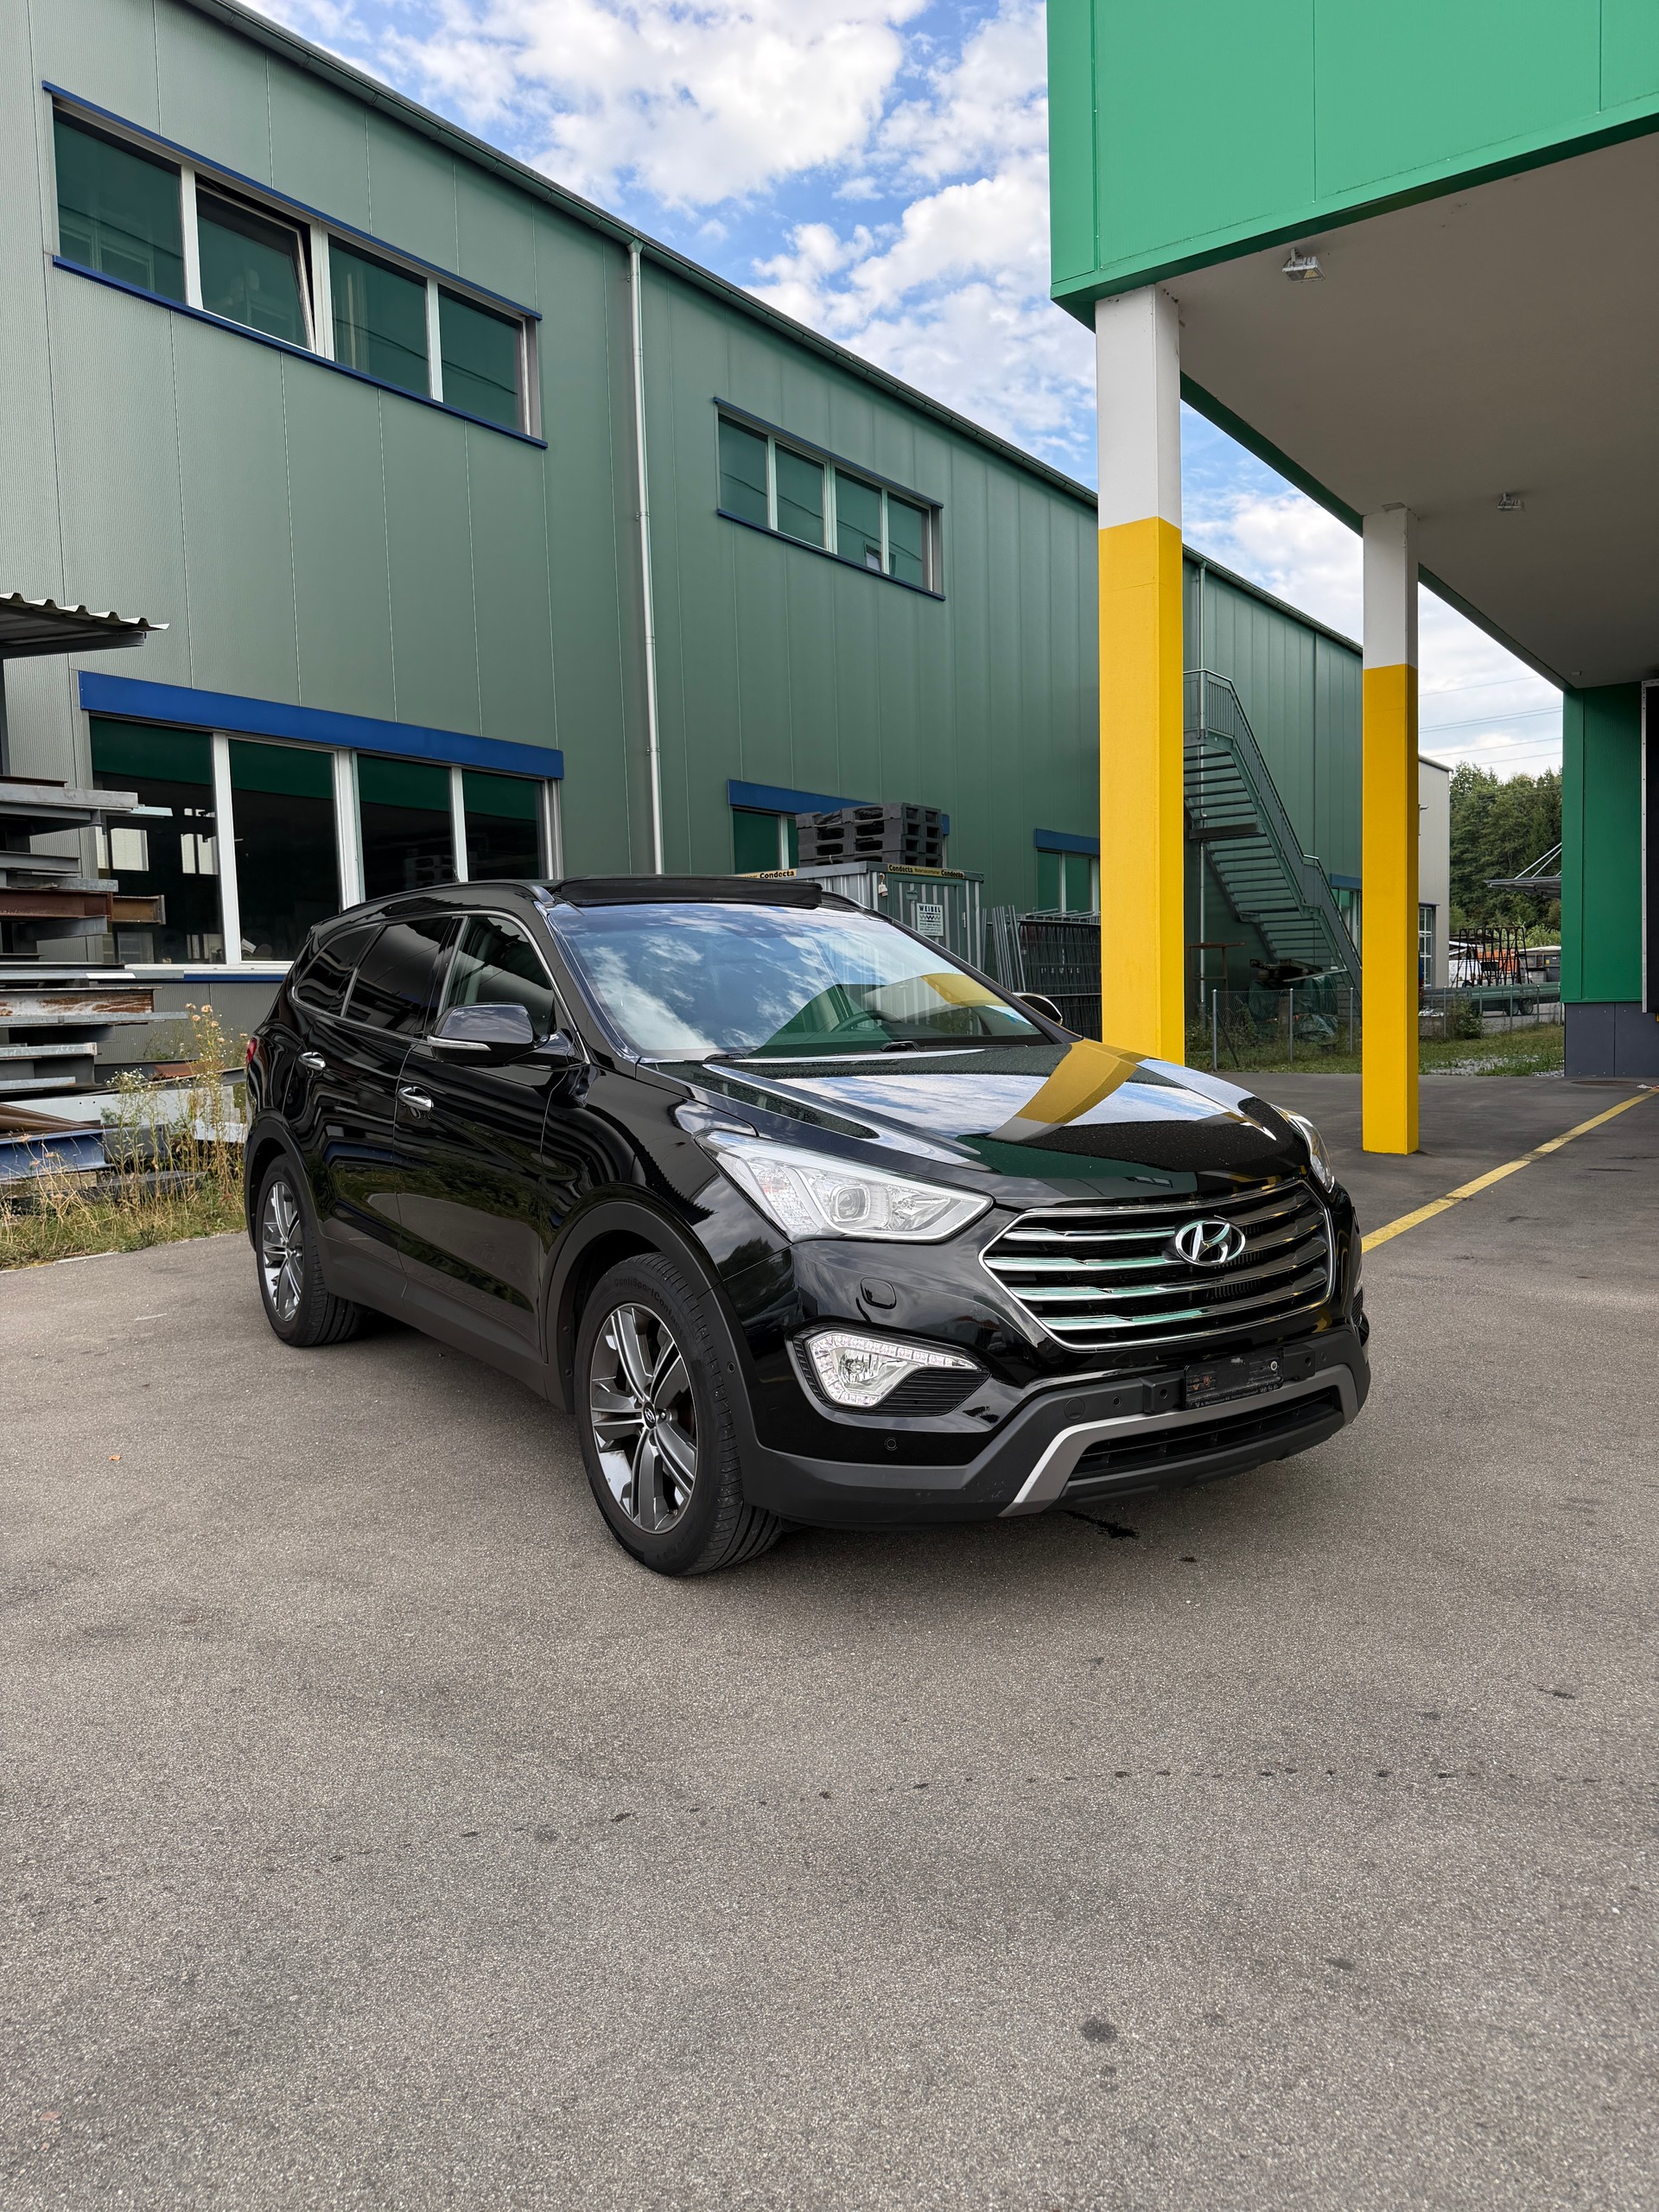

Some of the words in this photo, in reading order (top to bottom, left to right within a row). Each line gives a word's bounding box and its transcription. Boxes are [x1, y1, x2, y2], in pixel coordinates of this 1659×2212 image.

[760, 870, 794, 879] Condecta
[941, 869, 963, 878] Condecta
[919, 905, 941, 913] WEIBEL
